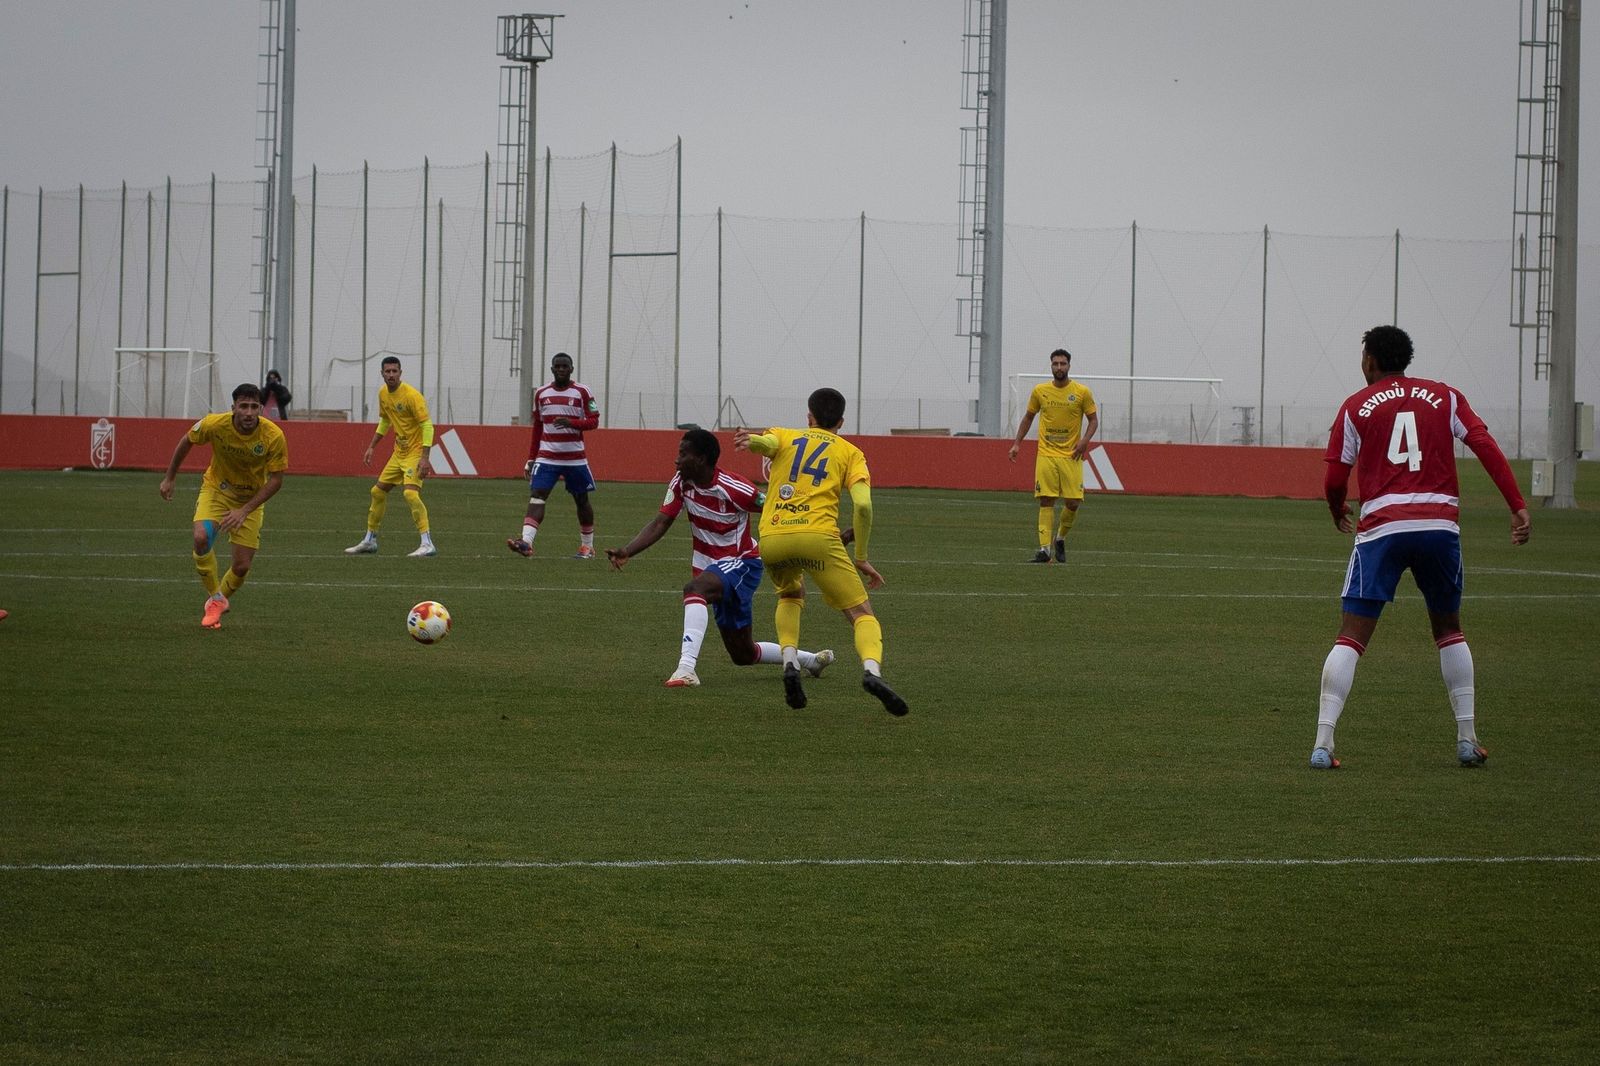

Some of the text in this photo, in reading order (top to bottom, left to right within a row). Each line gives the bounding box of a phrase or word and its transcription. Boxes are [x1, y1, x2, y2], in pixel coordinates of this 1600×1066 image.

[1410, 387, 1443, 409] FALL
[803, 433, 836, 443] OCHOA
[1387, 411, 1423, 472] 4
[791, 437, 830, 487] 14
